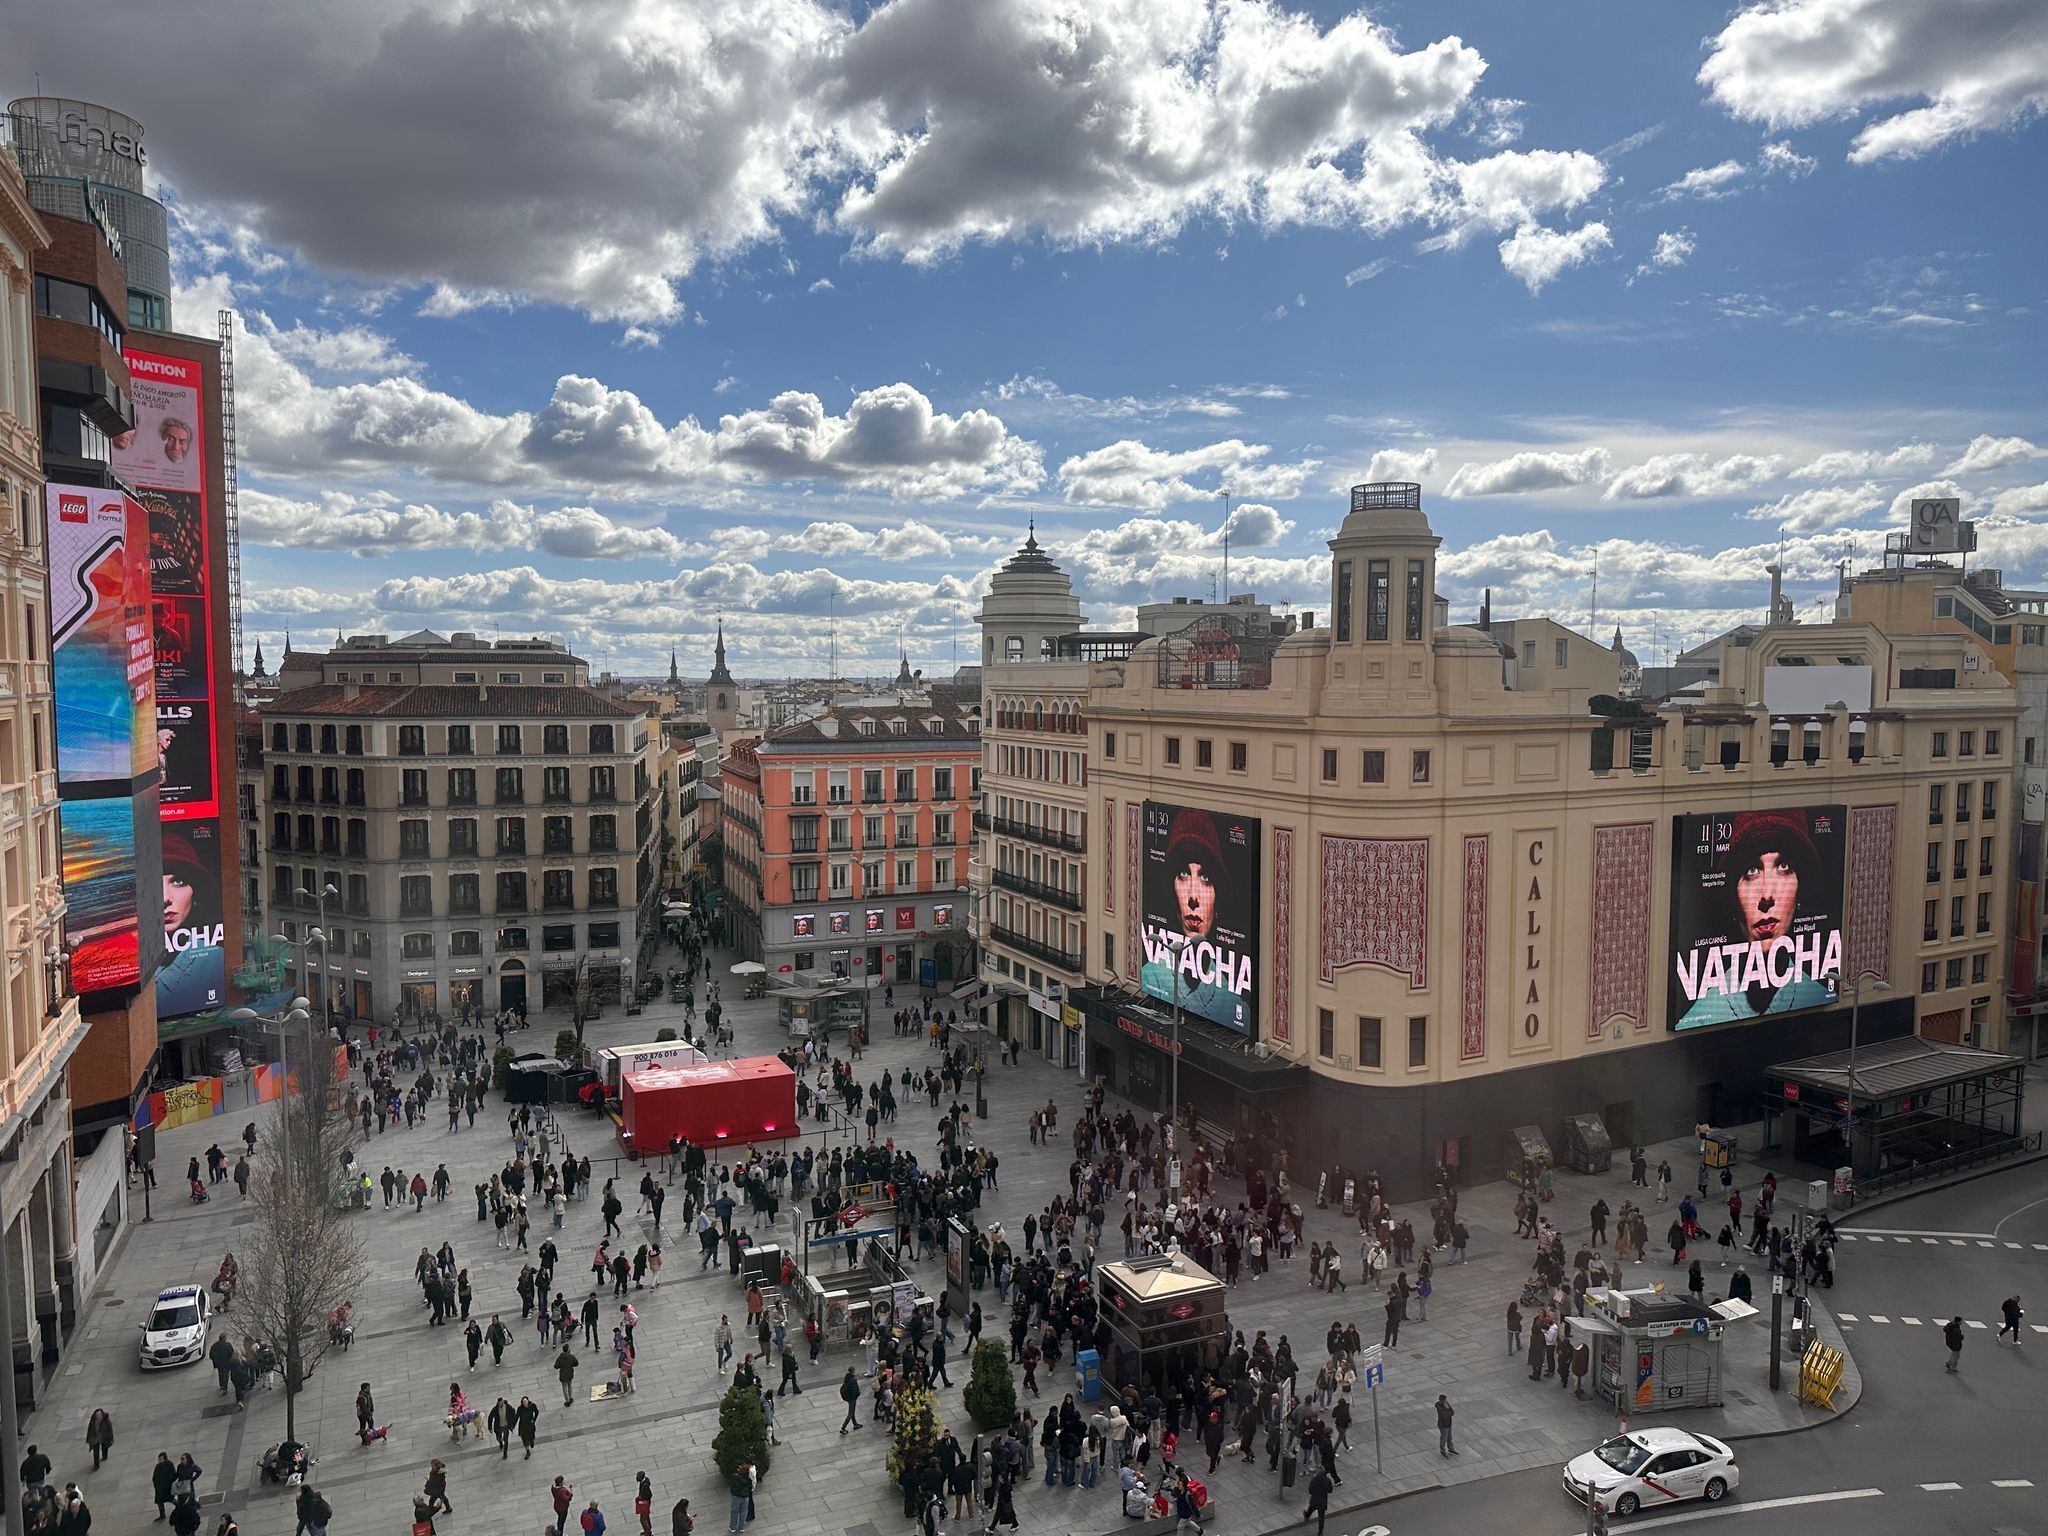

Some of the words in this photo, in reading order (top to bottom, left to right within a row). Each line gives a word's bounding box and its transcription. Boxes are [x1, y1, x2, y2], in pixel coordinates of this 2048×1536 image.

[58, 110, 147, 166] fnac
[132, 358, 186, 378] NATION
[62, 503, 85, 514] LEGO
[1158, 811, 1169, 826] 30
[1715, 822, 1733, 841] 30
[1697, 845, 1710, 854] FEB
[1715, 843, 1730, 852] MAR
[1524, 840, 1543, 1038] CALLAO
[1141, 922, 1252, 996] NATACHA
[1677, 929, 1842, 1001] NATACHA
[407, 970, 429, 978] Desigual
[455, 967, 477, 975] Desigual
[634, 1053, 648, 1061] 900
[664, 1050, 678, 1058] 016
